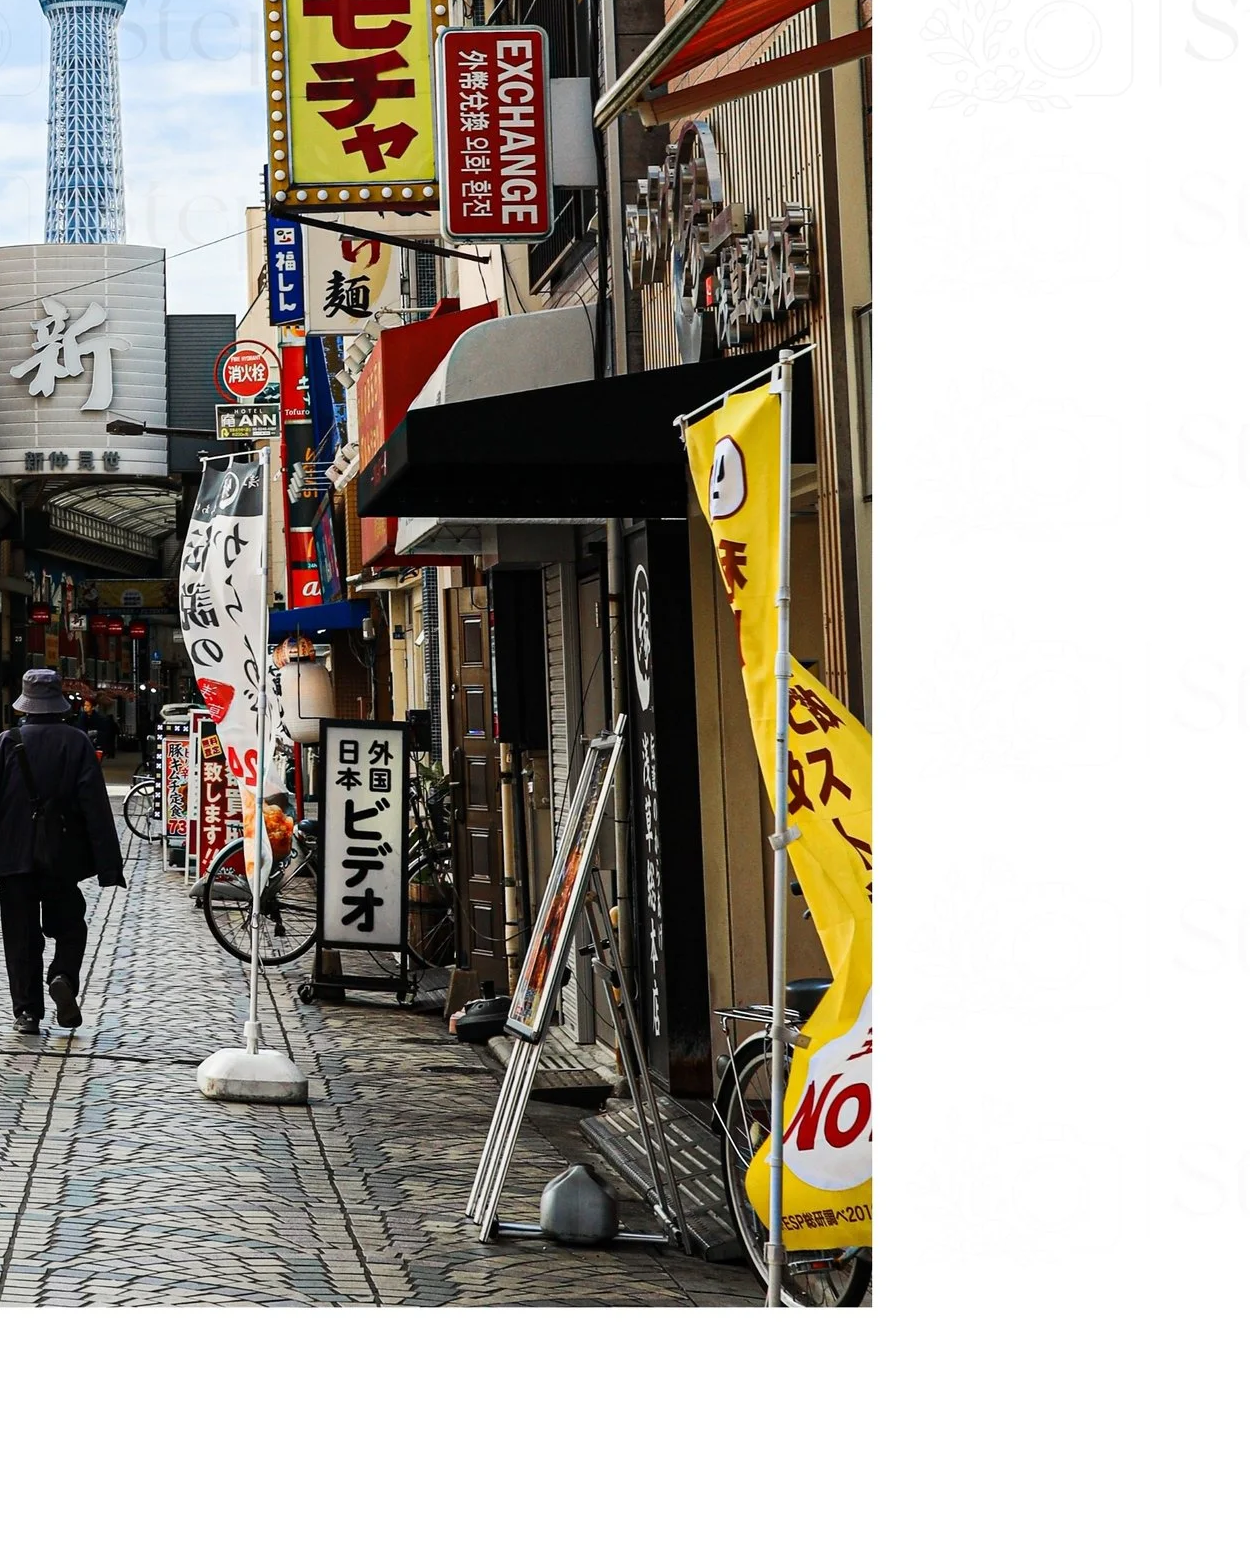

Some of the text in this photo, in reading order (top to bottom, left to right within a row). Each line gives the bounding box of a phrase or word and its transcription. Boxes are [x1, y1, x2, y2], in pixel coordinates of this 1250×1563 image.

[495, 39, 538, 226] EXCHANGE
[275, 251, 297, 312] 福しん
[10, 299, 132, 411] 新
[227, 362, 266, 383] 消火栓
[239, 414, 276, 426] ANN
[24, 450, 121, 472] 新仲見世
[168, 743, 184, 818] 豚キムチ定食
[335, 739, 363, 791] 日本
[368, 740, 394, 793] 外国
[341, 797, 393, 932] ビデオ
[782, 1072, 872, 1151] NO
